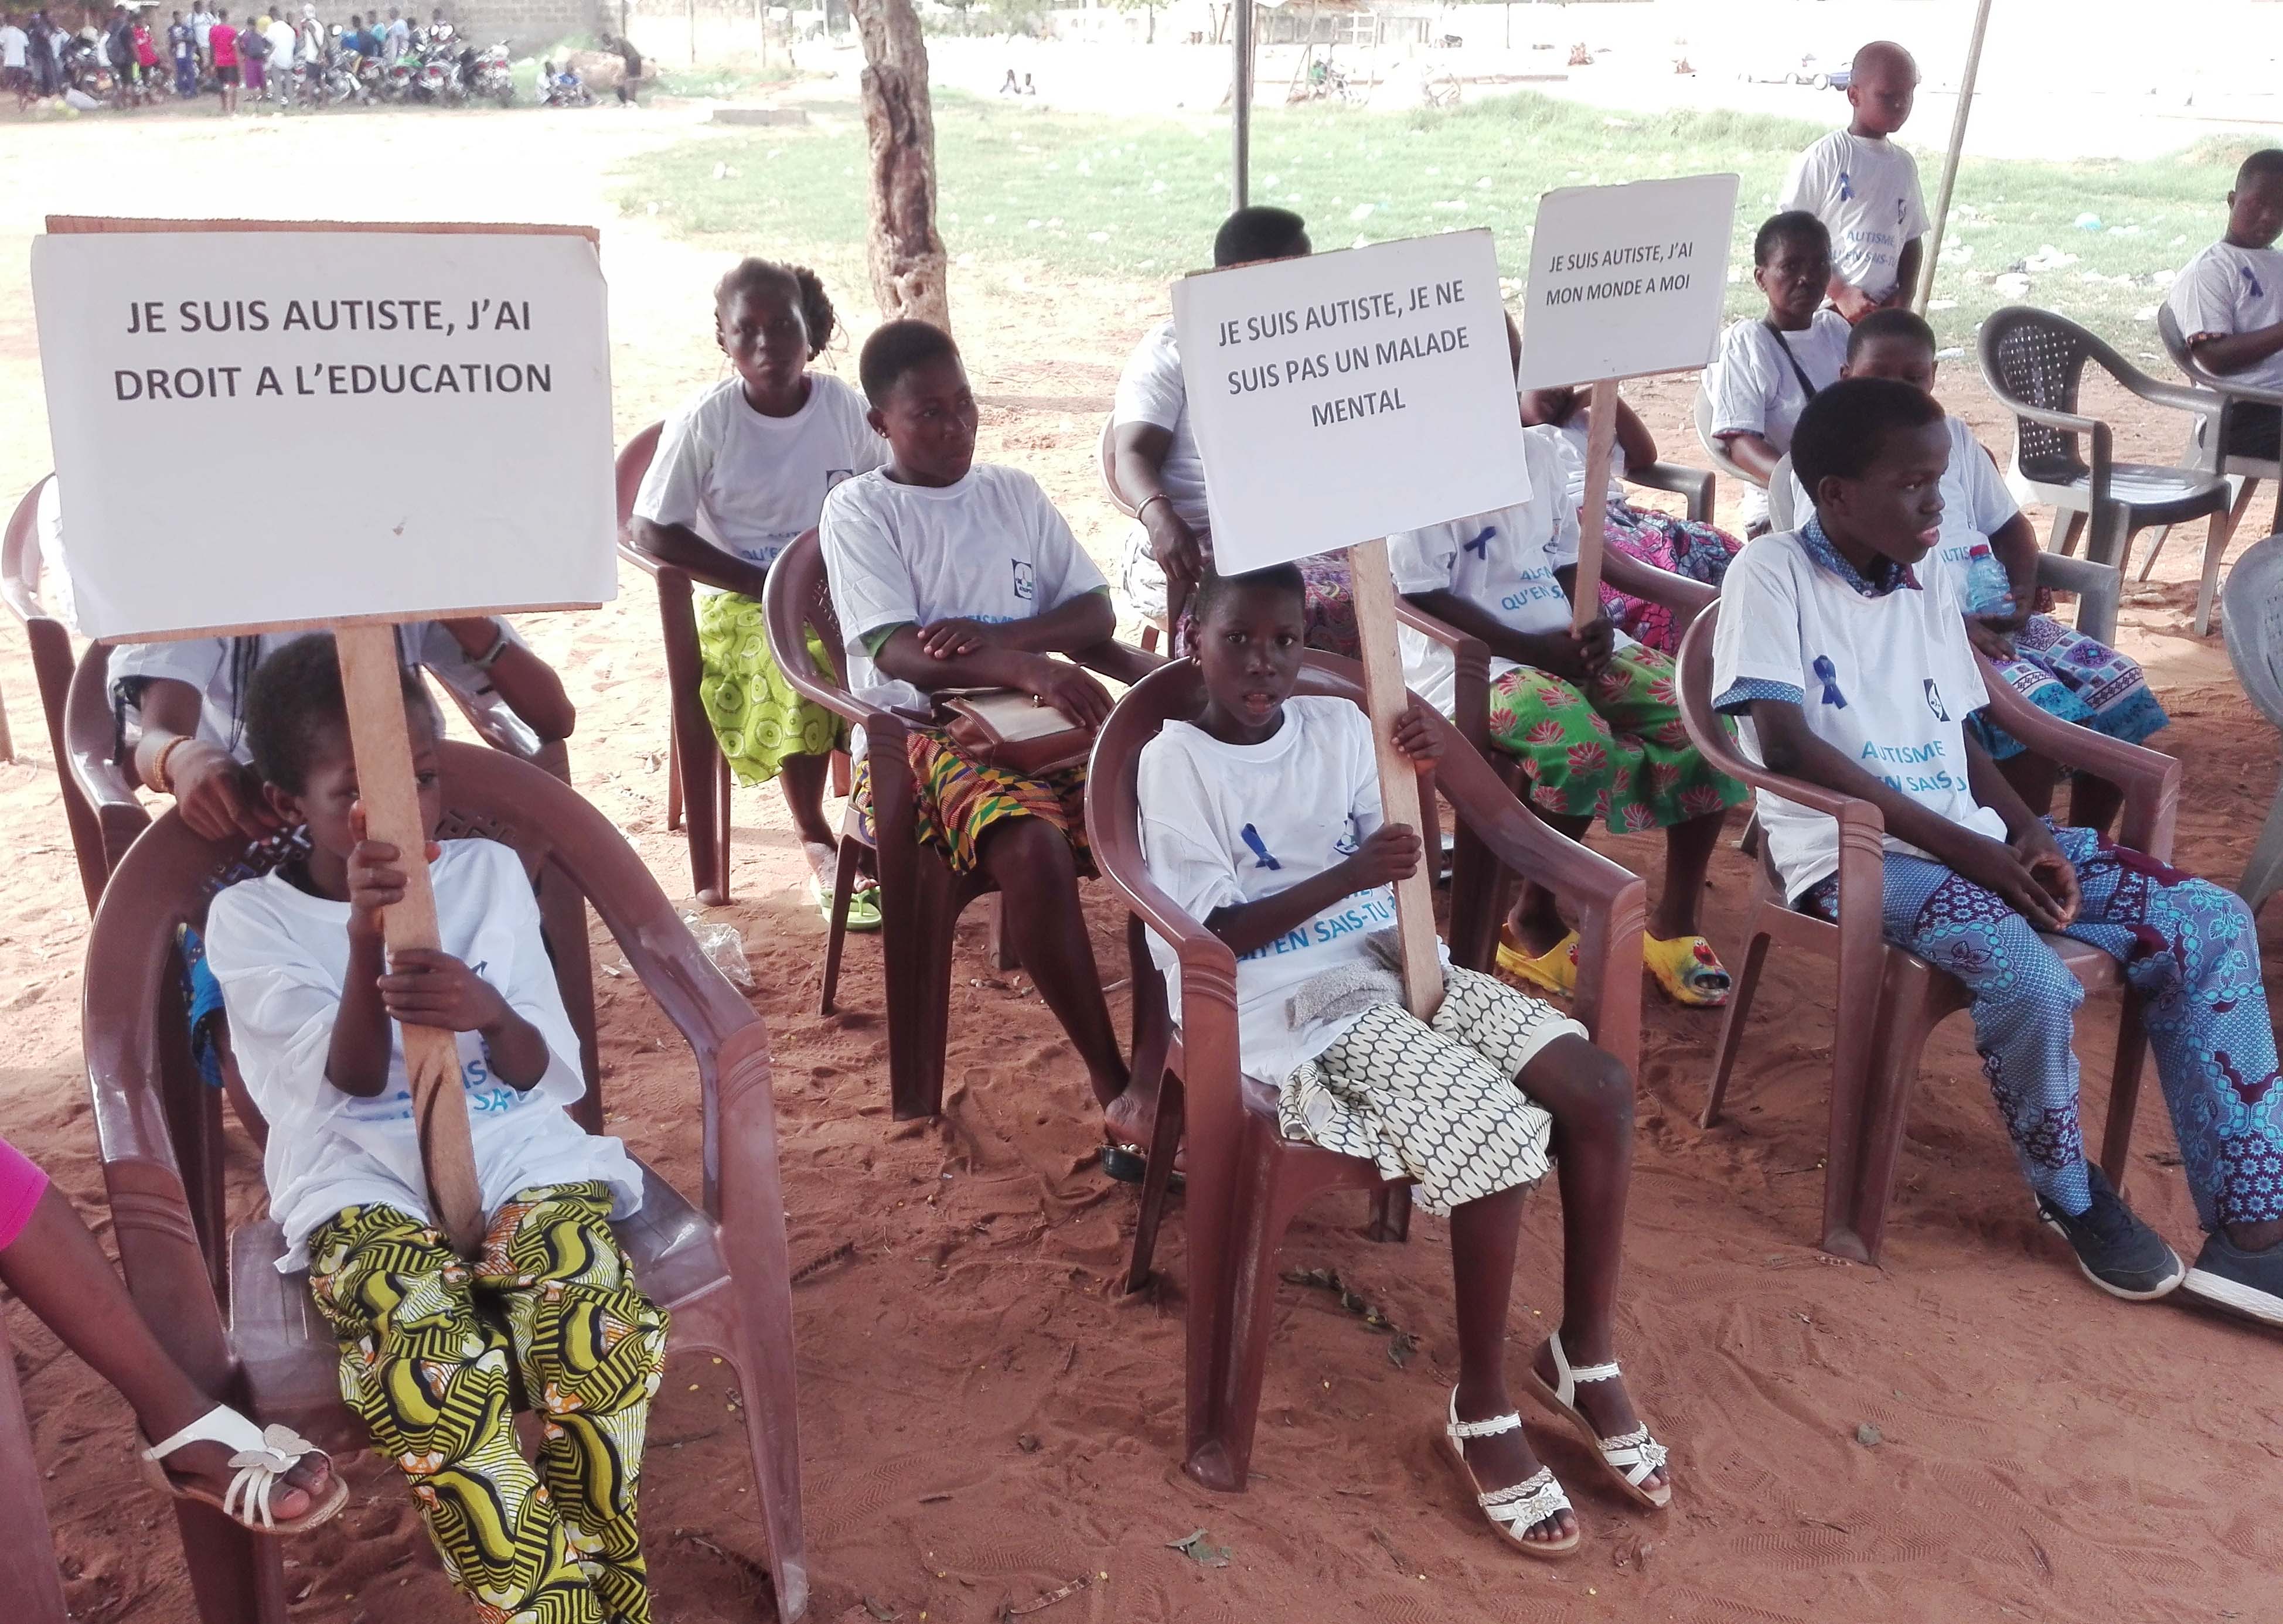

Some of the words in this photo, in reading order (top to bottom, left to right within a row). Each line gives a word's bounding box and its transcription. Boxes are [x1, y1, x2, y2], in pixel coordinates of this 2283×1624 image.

[1549, 255, 1563, 272] JE
[1568, 252, 1598, 270] SUIS
[1602, 245, 1663, 266] AUTISTE,
[1668, 242, 1692, 259] J'AI
[1546, 286, 1583, 306] MON
[1587, 279, 1642, 300] MONDE
[1645, 278, 1655, 293] A
[1660, 274, 1689, 291] MOI
[127, 302, 166, 333] JE
[180, 301, 269, 332] SUIS
[283, 300, 454, 336] AUTISTE,
[467, 299, 530, 330] J'AI
[1219, 320, 1241, 346] JE
[1248, 311, 1298, 340] SUIS
[1306, 292, 1402, 330] AUTISTE,
[1409, 286, 1429, 311] JE
[1436, 280, 1464, 305] NE
[1228, 364, 1279, 394] SUIS
[1286, 354, 1328, 383] PAS
[1335, 346, 1369, 373] UN
[1376, 327, 1469, 365] MALADE
[115, 367, 241, 400] DROIT
[255, 367, 282, 397] A
[297, 363, 550, 394] L'EDUCATION
[1312, 388, 1406, 427] MENTAL
[1501, 586, 1551, 610] QU'EN
[1862, 740, 1945, 763] AUTISME
[1314, 900, 1389, 942] SAIS-TU
